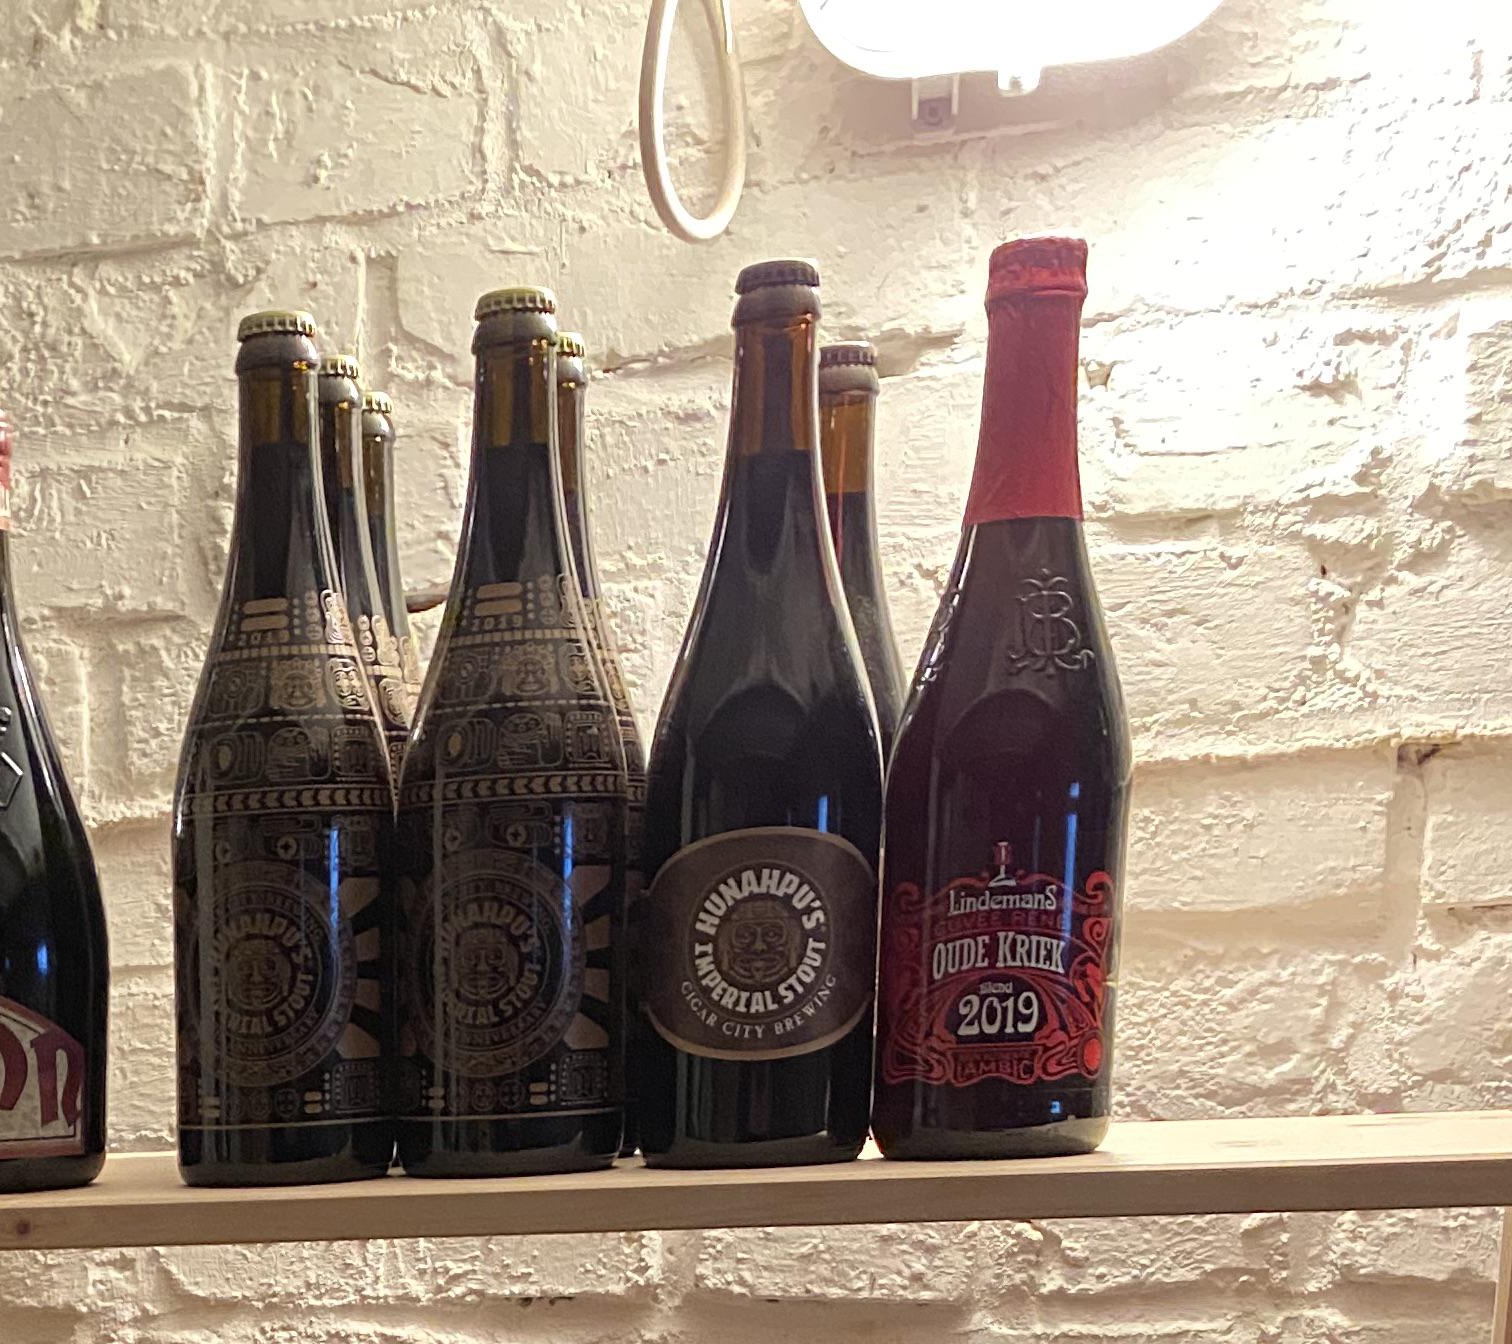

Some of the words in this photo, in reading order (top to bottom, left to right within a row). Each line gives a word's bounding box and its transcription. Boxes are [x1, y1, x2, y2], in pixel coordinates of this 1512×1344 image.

[695, 867, 827, 936] HUNAHPU'S
[695, 941, 778, 1014] IMPERIAL
[777, 937, 827, 1005] STOUT
[932, 936, 990, 981] OUDE
[995, 931, 1067, 974] KRIEK
[682, 981, 718, 1028] CIGAR
[721, 1021, 765, 1040] CITY
[774, 974, 838, 1036] BREWING
[957, 991, 1040, 1036] 2019
